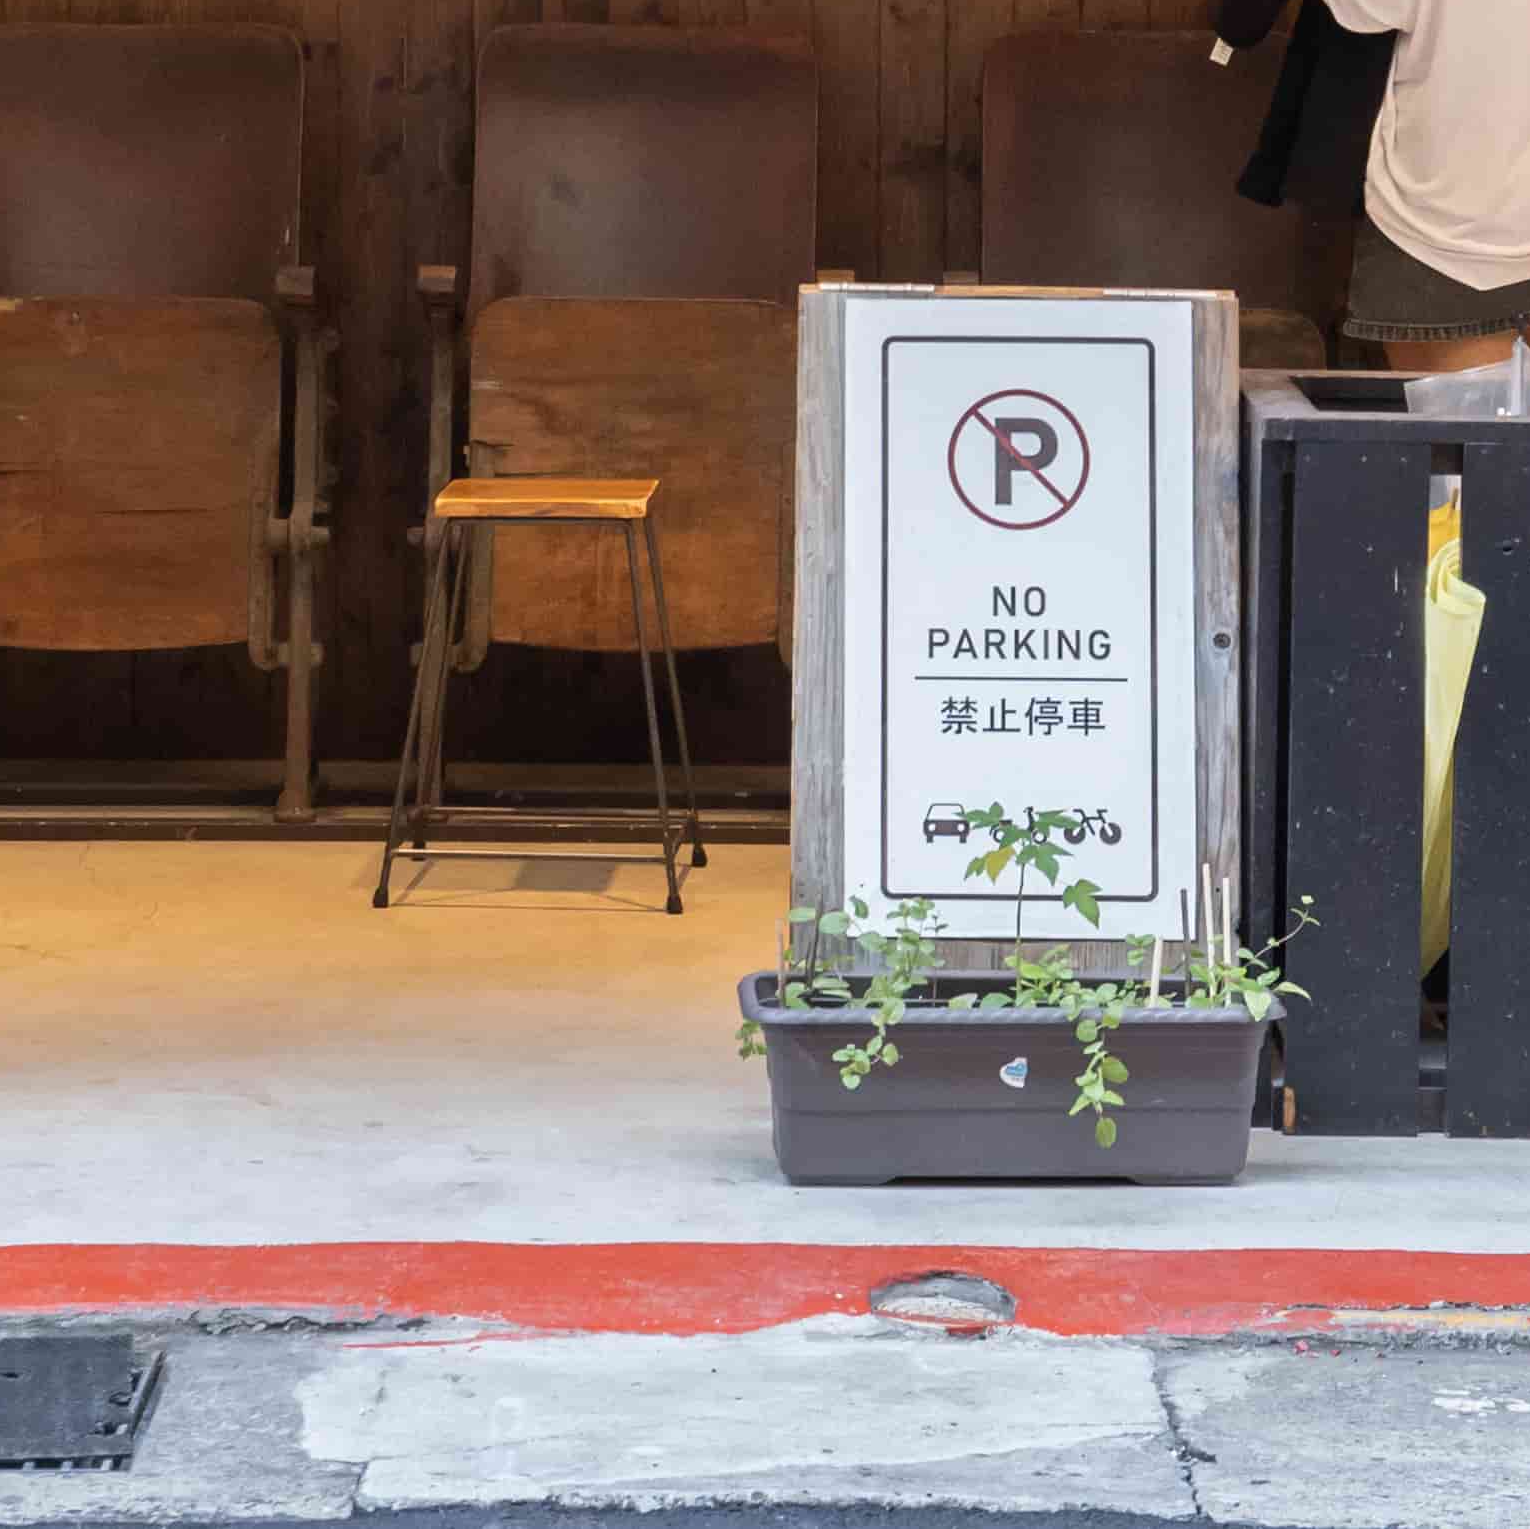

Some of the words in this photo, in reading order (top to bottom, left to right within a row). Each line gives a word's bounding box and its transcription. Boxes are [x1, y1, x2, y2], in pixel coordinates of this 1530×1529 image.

[991, 585, 1046, 617] NO
[927, 628, 1112, 661] PARKING
[940, 696, 1106, 737] 禁止停車
